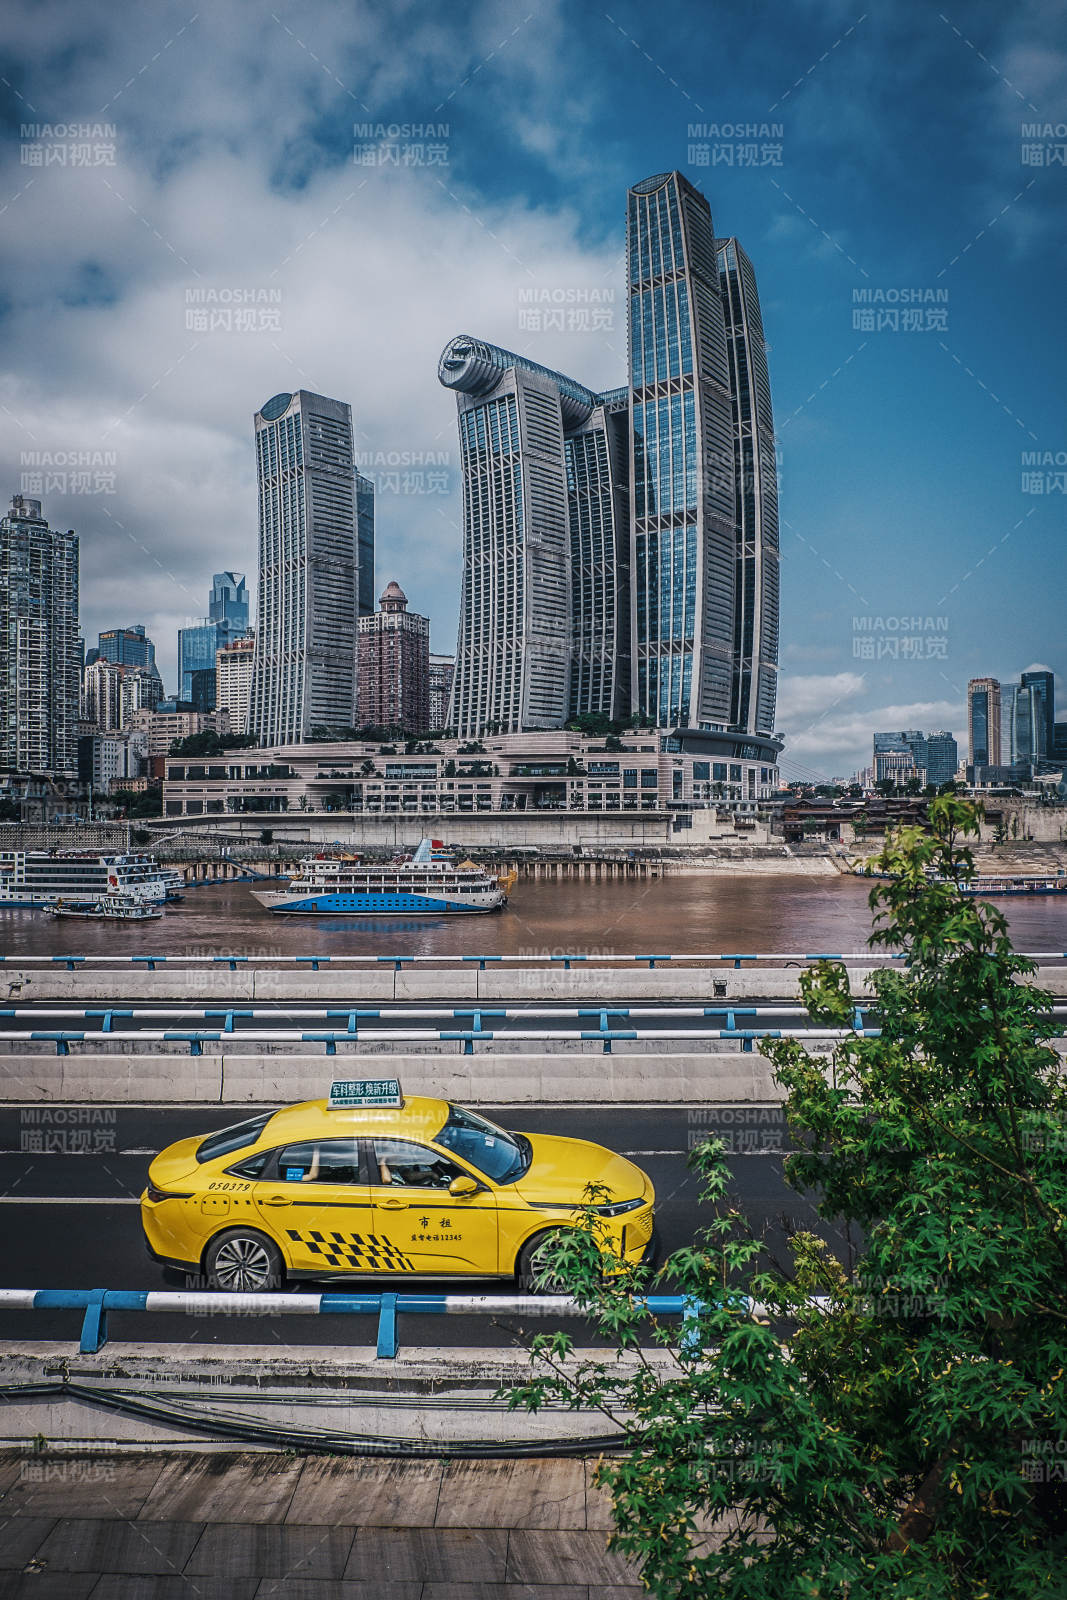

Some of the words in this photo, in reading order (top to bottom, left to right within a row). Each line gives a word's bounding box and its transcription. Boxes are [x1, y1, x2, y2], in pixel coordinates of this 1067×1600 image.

[332, 1083, 364, 1097] 军科整形
[365, 1081, 397, 1096] 焕新升级
[208, 1182, 251, 1192] 050379
